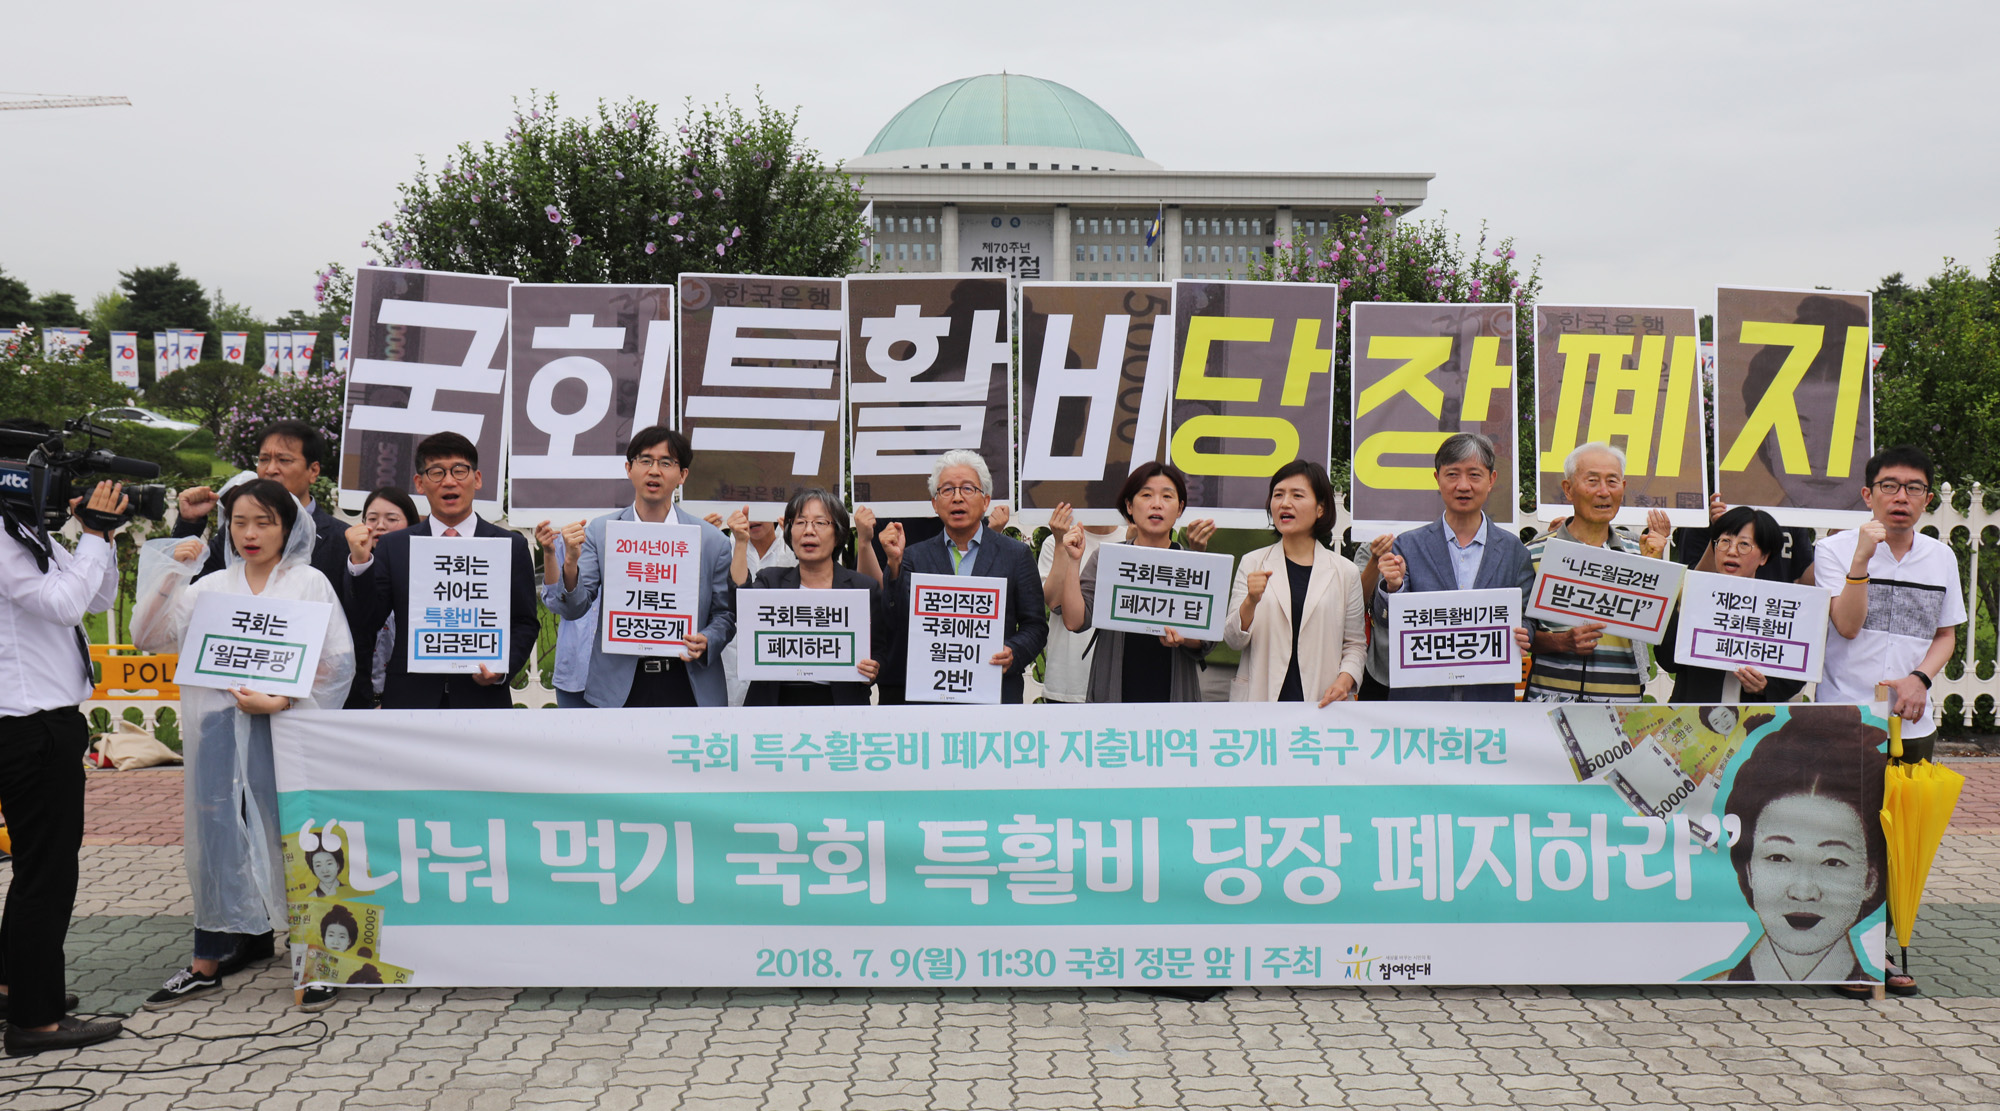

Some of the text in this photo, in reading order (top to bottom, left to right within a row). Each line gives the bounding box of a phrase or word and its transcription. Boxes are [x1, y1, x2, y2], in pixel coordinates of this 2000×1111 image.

[982, 242, 1031, 254] 제70주년
[1559, 312, 1664, 336] 한국은행
[116, 345, 135, 360] 70
[225, 346, 241, 359] 70
[297, 345, 313, 359] 70
[616, 539, 689, 557] 2014년이후
[434, 555, 489, 575] 국회는
[626, 561, 677, 584] 특활비
[1118, 561, 1210, 590] 국회특활비
[433, 581, 489, 601] 쉬어도
[625, 590, 677, 611] 기록도
[923, 592, 993, 614] 꿈의직장
[1120, 594, 1203, 621] 폐지가 답
[232, 611, 288, 637] 국회는
[424, 607, 497, 627] 특활비는
[757, 605, 849, 627] 국회특활비
[1402, 605, 1509, 627] 국회특활비기록
[1713, 612, 1793, 639] 국회특활비
[616, 617, 685, 640] 당장공개
[922, 617, 990, 639] 국회에선
[424, 633, 497, 653] 입금된다
[767, 637, 841, 659] 폐지하라
[930, 642, 980, 664] 월급이
[1410, 630, 1502, 661] 전면공개
[1715, 637, 1784, 664] 폐지하라
[124, 663, 178, 683] POL
[933, 669, 973, 693] 2번!
[668, 727, 1508, 773] 국회 특수활동비 폐지와 지출내역 공개 촉구 기자회견
[1586, 740, 1632, 773] 50000
[1653, 779, 1696, 820] 50000
[532, 819, 696, 905] 먹기
[726, 819, 887, 906] 국회
[915, 814, 1160, 906] 특활비
[1187, 815, 1353, 905] 당장
[364, 908, 377, 945] 50000
[757, 949, 842, 979] 2018.
[854, 950, 879, 978] 7.
[891, 948, 967, 981] 9(월)
[978, 949, 1057, 977] 11:30
[1066, 947, 1125, 980] 국회
[1136, 948, 1195, 980] 정문
[1204, 948, 1235, 979] 앞
[1262, 946, 1322, 979] 주최
[1379, 963, 1431, 980] 참여연대
